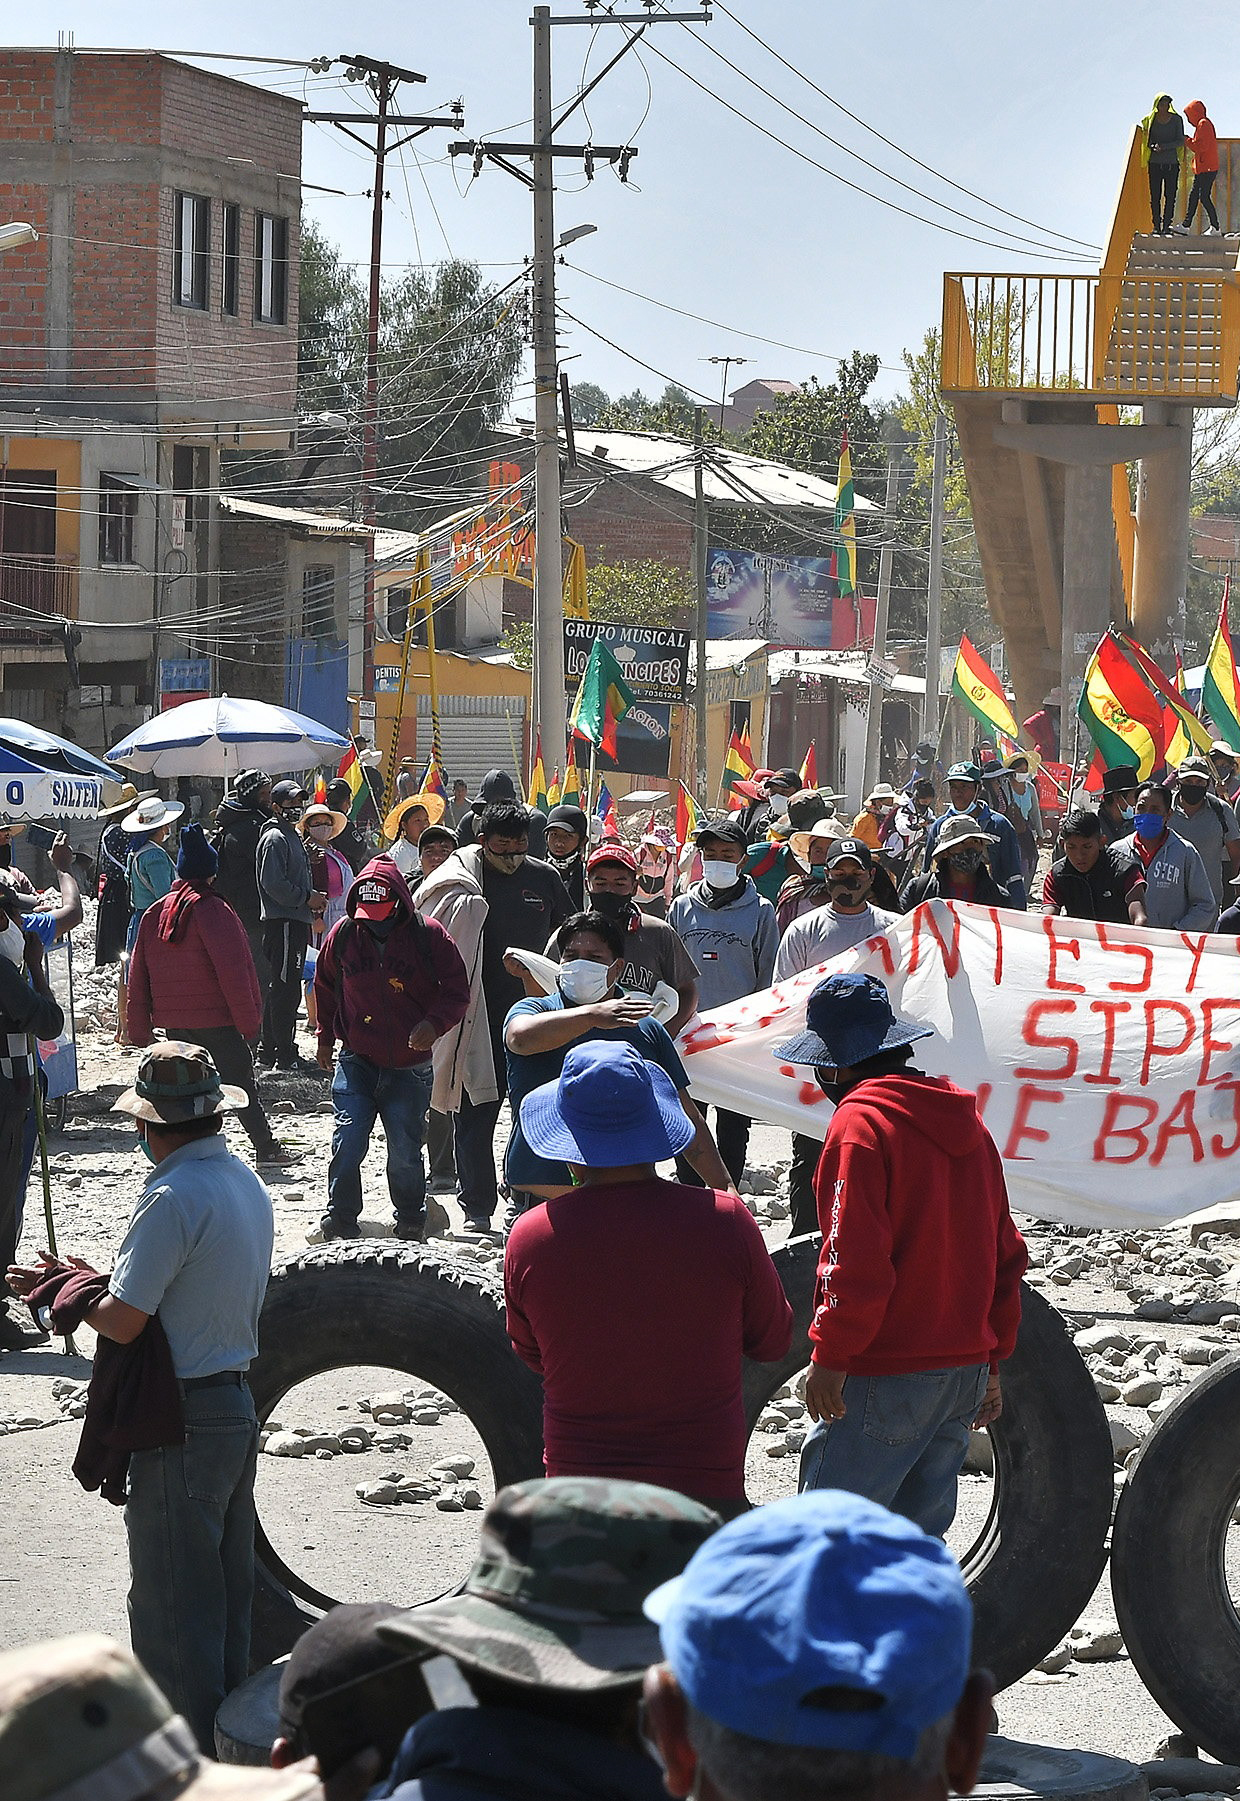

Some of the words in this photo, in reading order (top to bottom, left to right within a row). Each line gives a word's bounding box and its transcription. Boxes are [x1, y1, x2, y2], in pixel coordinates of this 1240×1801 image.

[565, 622, 616, 641] GRUPO
[620, 627, 687, 648] MUSICAL
[567, 646, 589, 675] LO
[625, 706, 667, 740] ACION
[53, 779, 103, 808] SALTEÑ
[358, 884, 387, 896] CHICAGO
[363, 893, 381, 902] BULLS
[1180, 931, 1207, 993] Y
